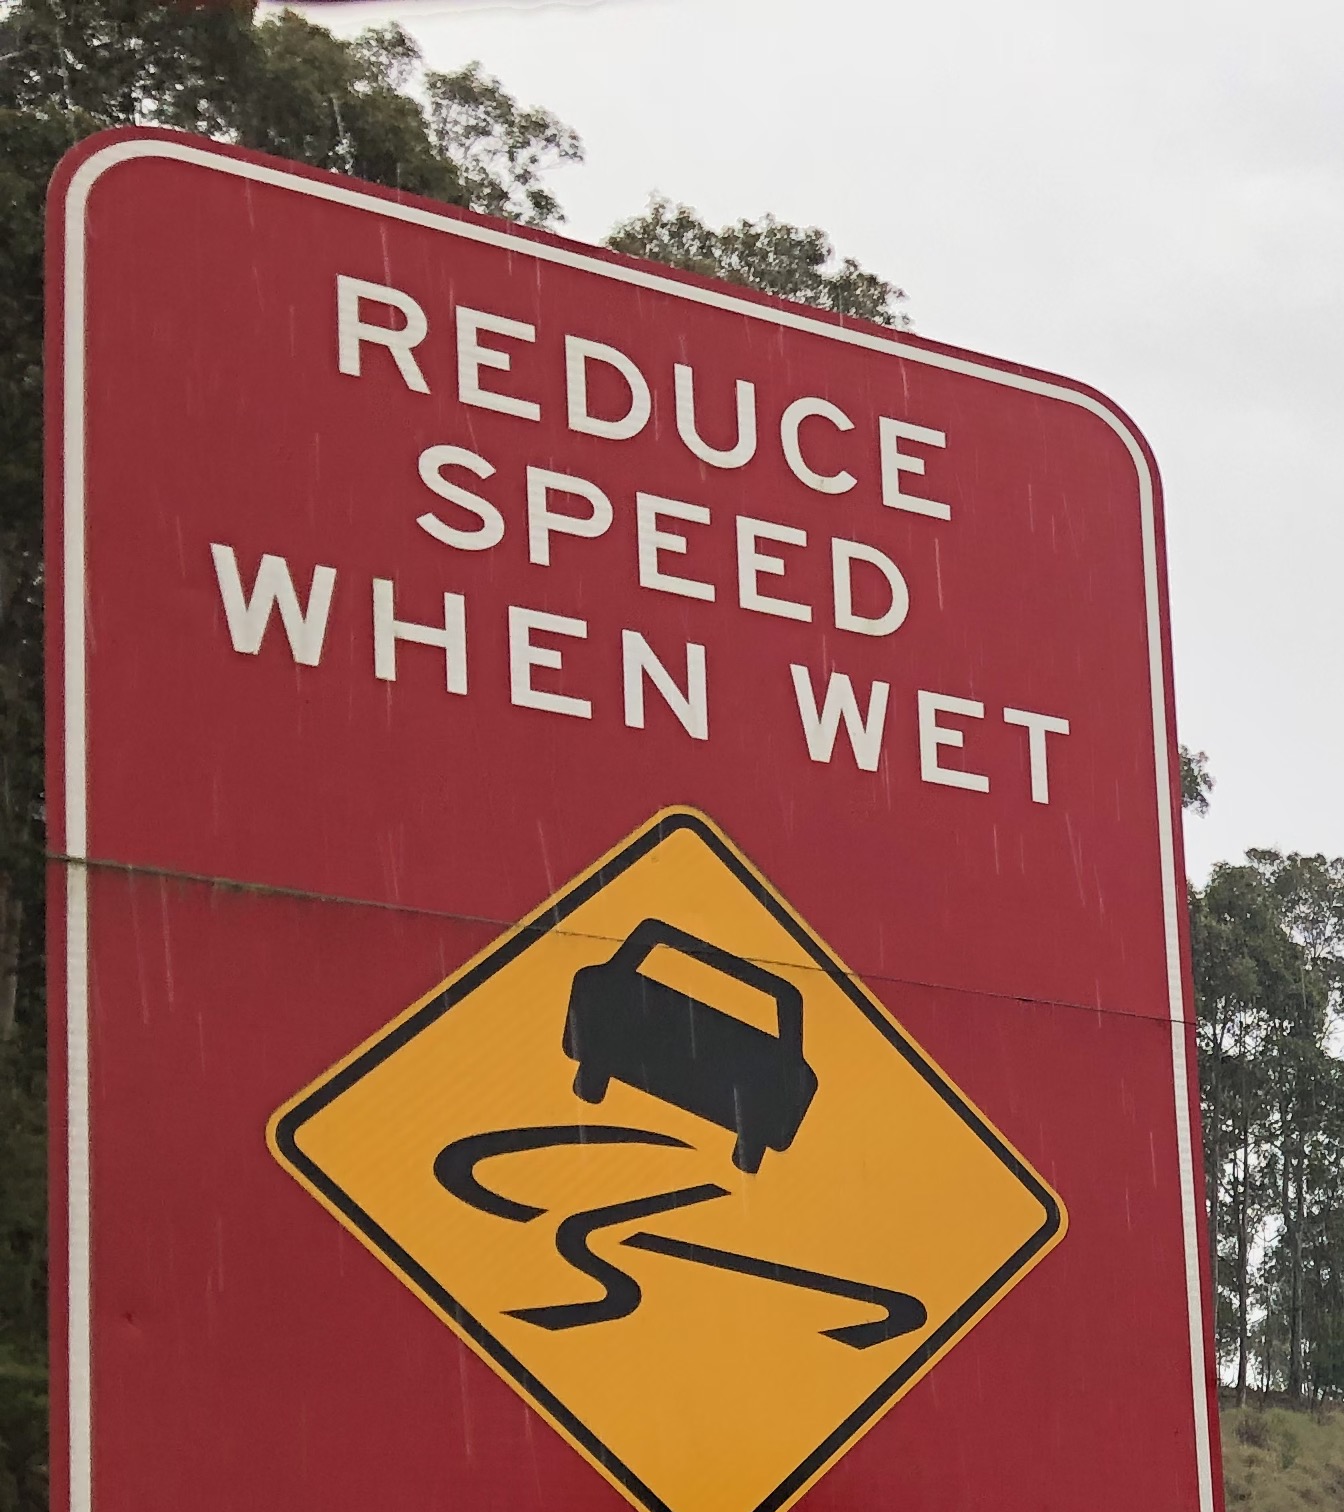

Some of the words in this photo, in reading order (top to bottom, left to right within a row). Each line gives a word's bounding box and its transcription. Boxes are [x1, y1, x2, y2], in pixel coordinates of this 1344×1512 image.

[336, 274, 952, 521] REDUCE
[416, 444, 910, 636] SPEED
[210, 542, 709, 741] WHEN
[789, 663, 1070, 804] WET
